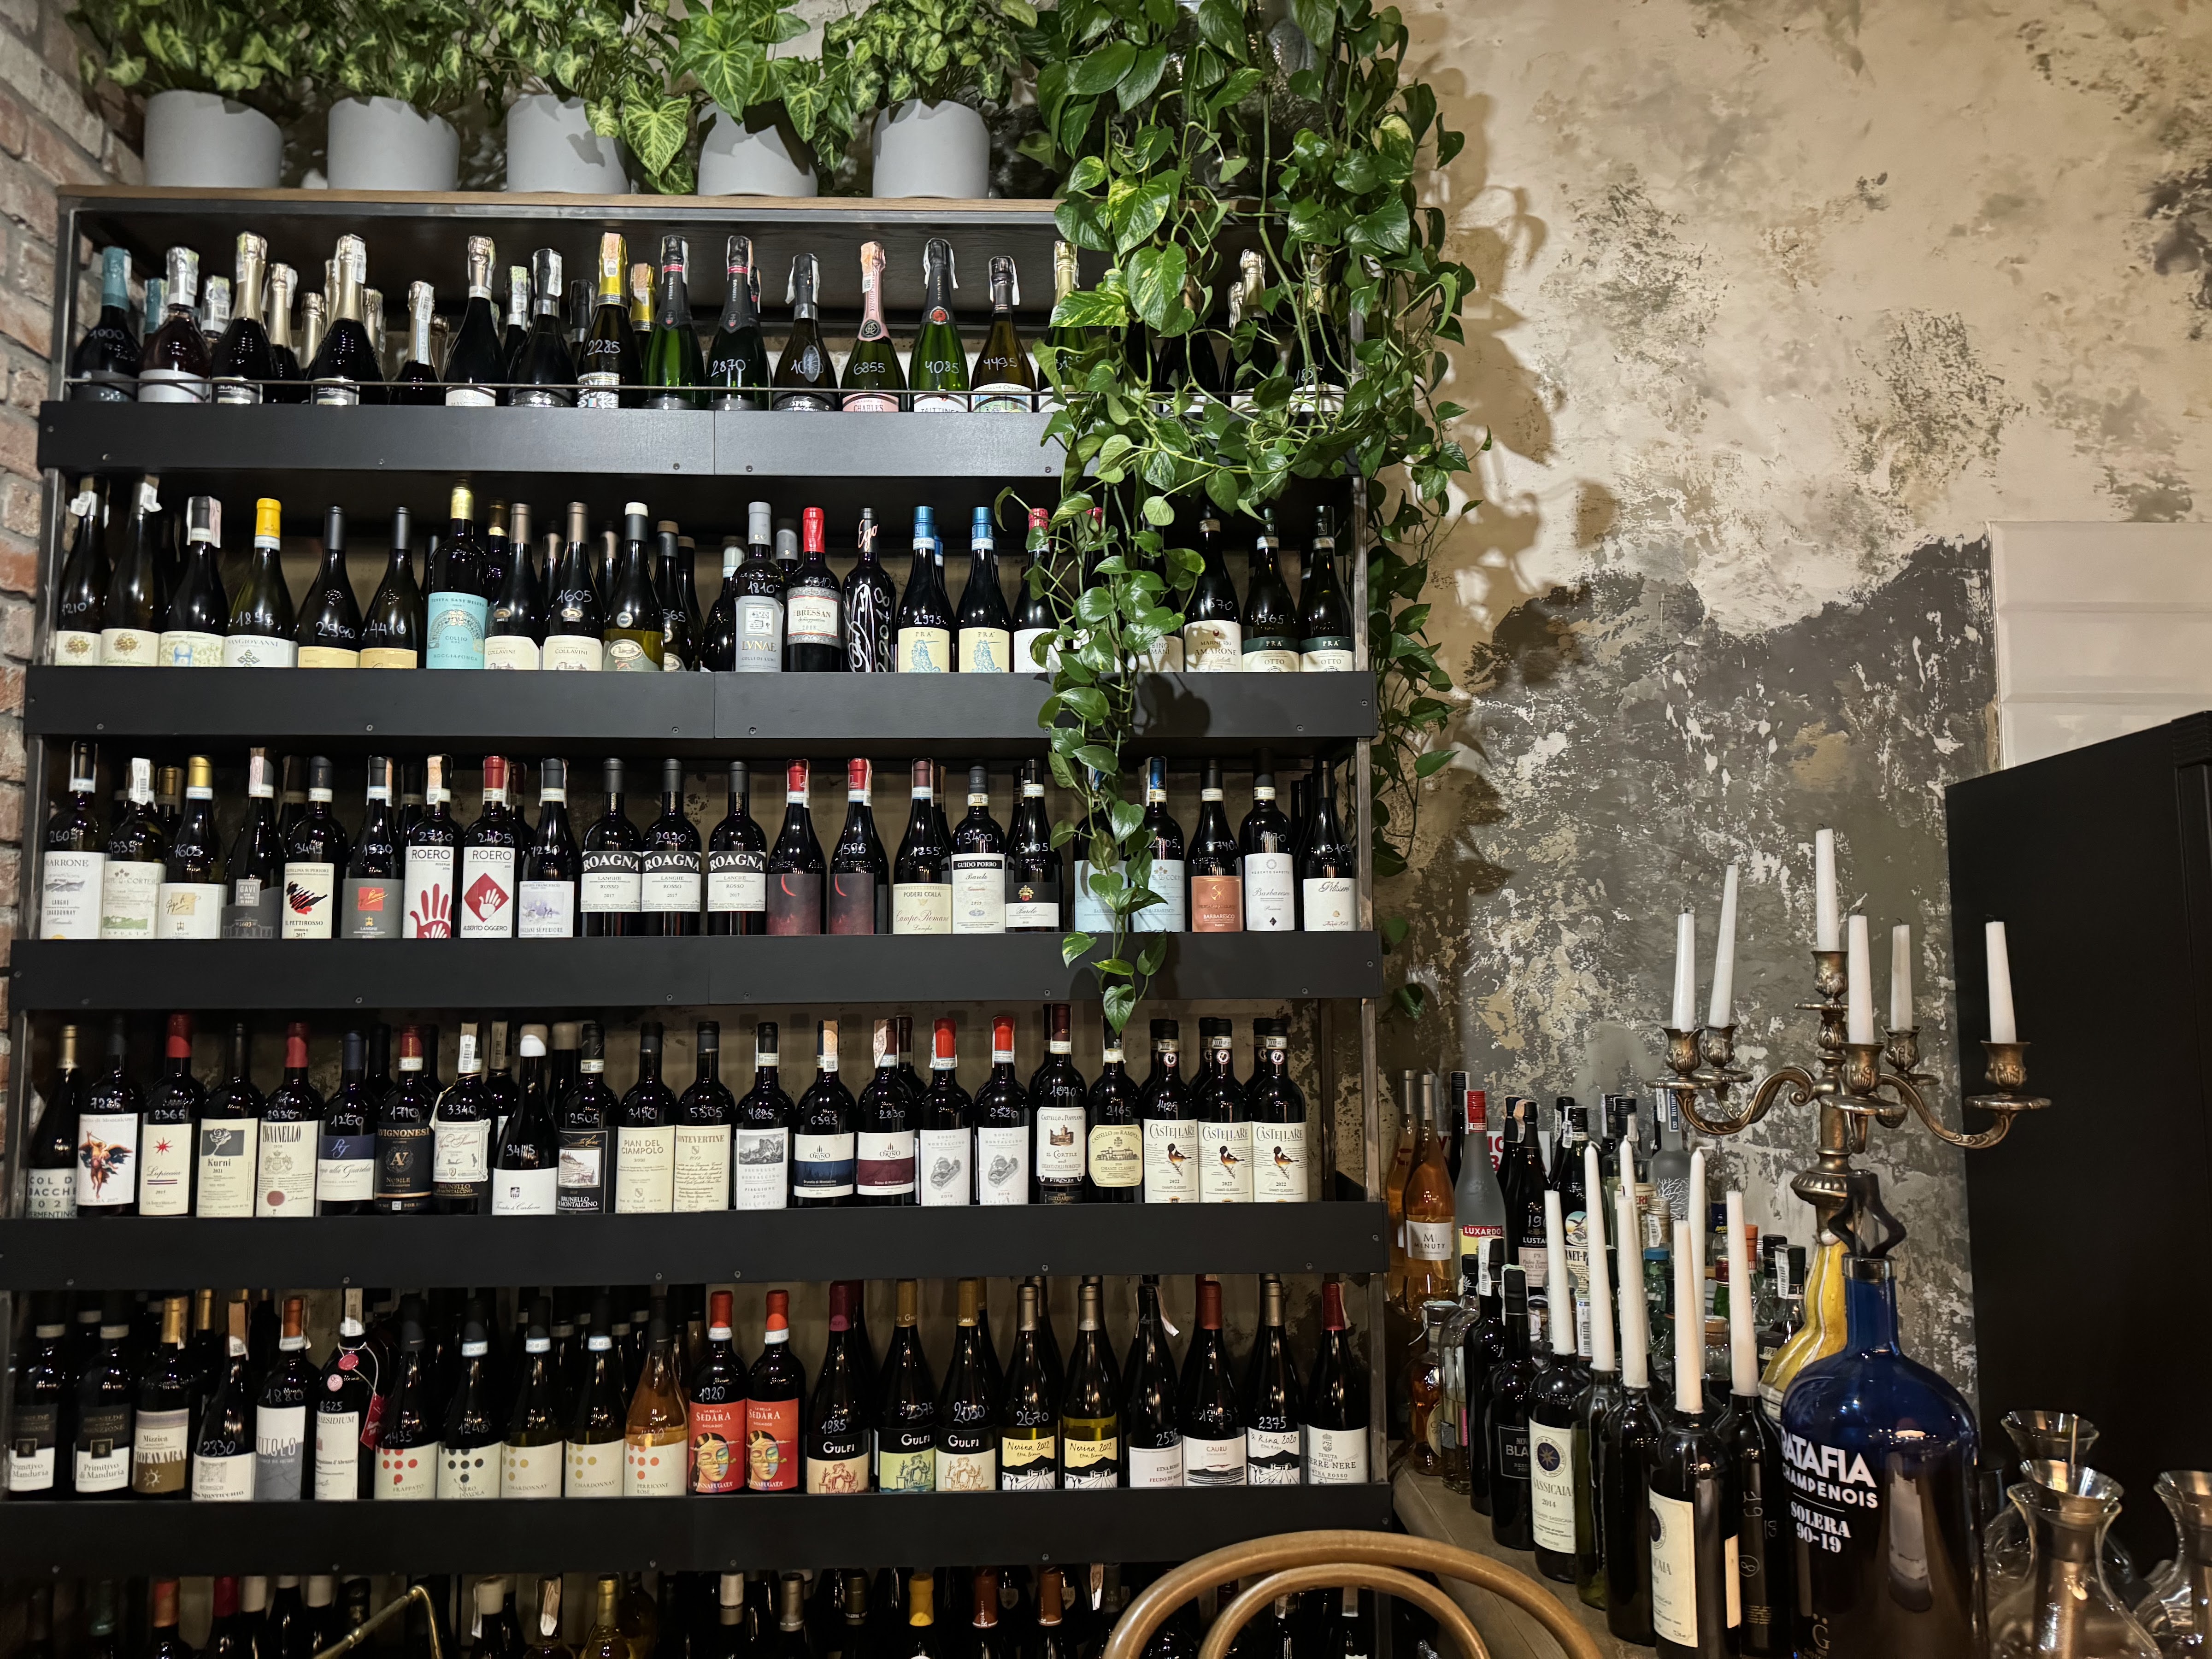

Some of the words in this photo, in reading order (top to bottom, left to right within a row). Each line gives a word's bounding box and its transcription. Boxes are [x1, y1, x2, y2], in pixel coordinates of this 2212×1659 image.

[587, 339, 621, 356] 2285
[711, 359, 746, 377] 2870
[853, 362, 885, 375] 6855
[924, 360, 959, 374] 4085
[983, 357, 1017, 371] 4495
[858, 519, 878, 553] Ego
[747, 582, 775, 594] 1810
[557, 589, 592, 603] 1605
[741, 640, 777, 652] LVNAE
[412, 850, 450, 859] ROERO
[473, 850, 512, 860] ROERO
[582, 854, 639, 872] ROAGNA
[644, 853, 700, 872] ROAGNA
[710, 853, 764, 872] ROAGNA
[570, 1112, 600, 1124] 2505
[690, 1107, 723, 1118] 5305
[879, 1109, 906, 1119] 2830
[989, 1107, 1018, 1118] 2520
[1106, 1105, 1131, 1117] 2165
[1150, 1124, 1196, 1139] CASTELLARE
[1202, 1126, 1249, 1141] CASTELLARE
[1256, 1126, 1303, 1142] CASTELLARE
[208, 1158, 231, 1167] Kurni
[29, 1177, 53, 1185] COL
[1464, 1227, 1502, 1235] LUXARDO
[699, 1386, 725, 1403] 1920
[1016, 1410, 1049, 1426] 2670
[1259, 1416, 1287, 1429] 2375
[821, 1419, 847, 1434] 1985
[901, 1434, 930, 1446] GULFI
[948, 1435, 979, 1447] GULFI
[1156, 1427, 1178, 1447] 2535
[1282, 1435, 1296, 1444] 2020
[203, 1439, 236, 1457] 2330
[258, 1437, 296, 1457] TITOLO
[823, 1441, 855, 1453] GULFI
[1506, 1444, 1529, 1457] BLA
[1332, 1461, 1356, 1470] NERE
[1782, 1462, 1878, 1508] CHAMPENOIS
[1790, 1501, 1852, 1538] SOLERA
[1796, 1522, 1841, 1553] 90-19
